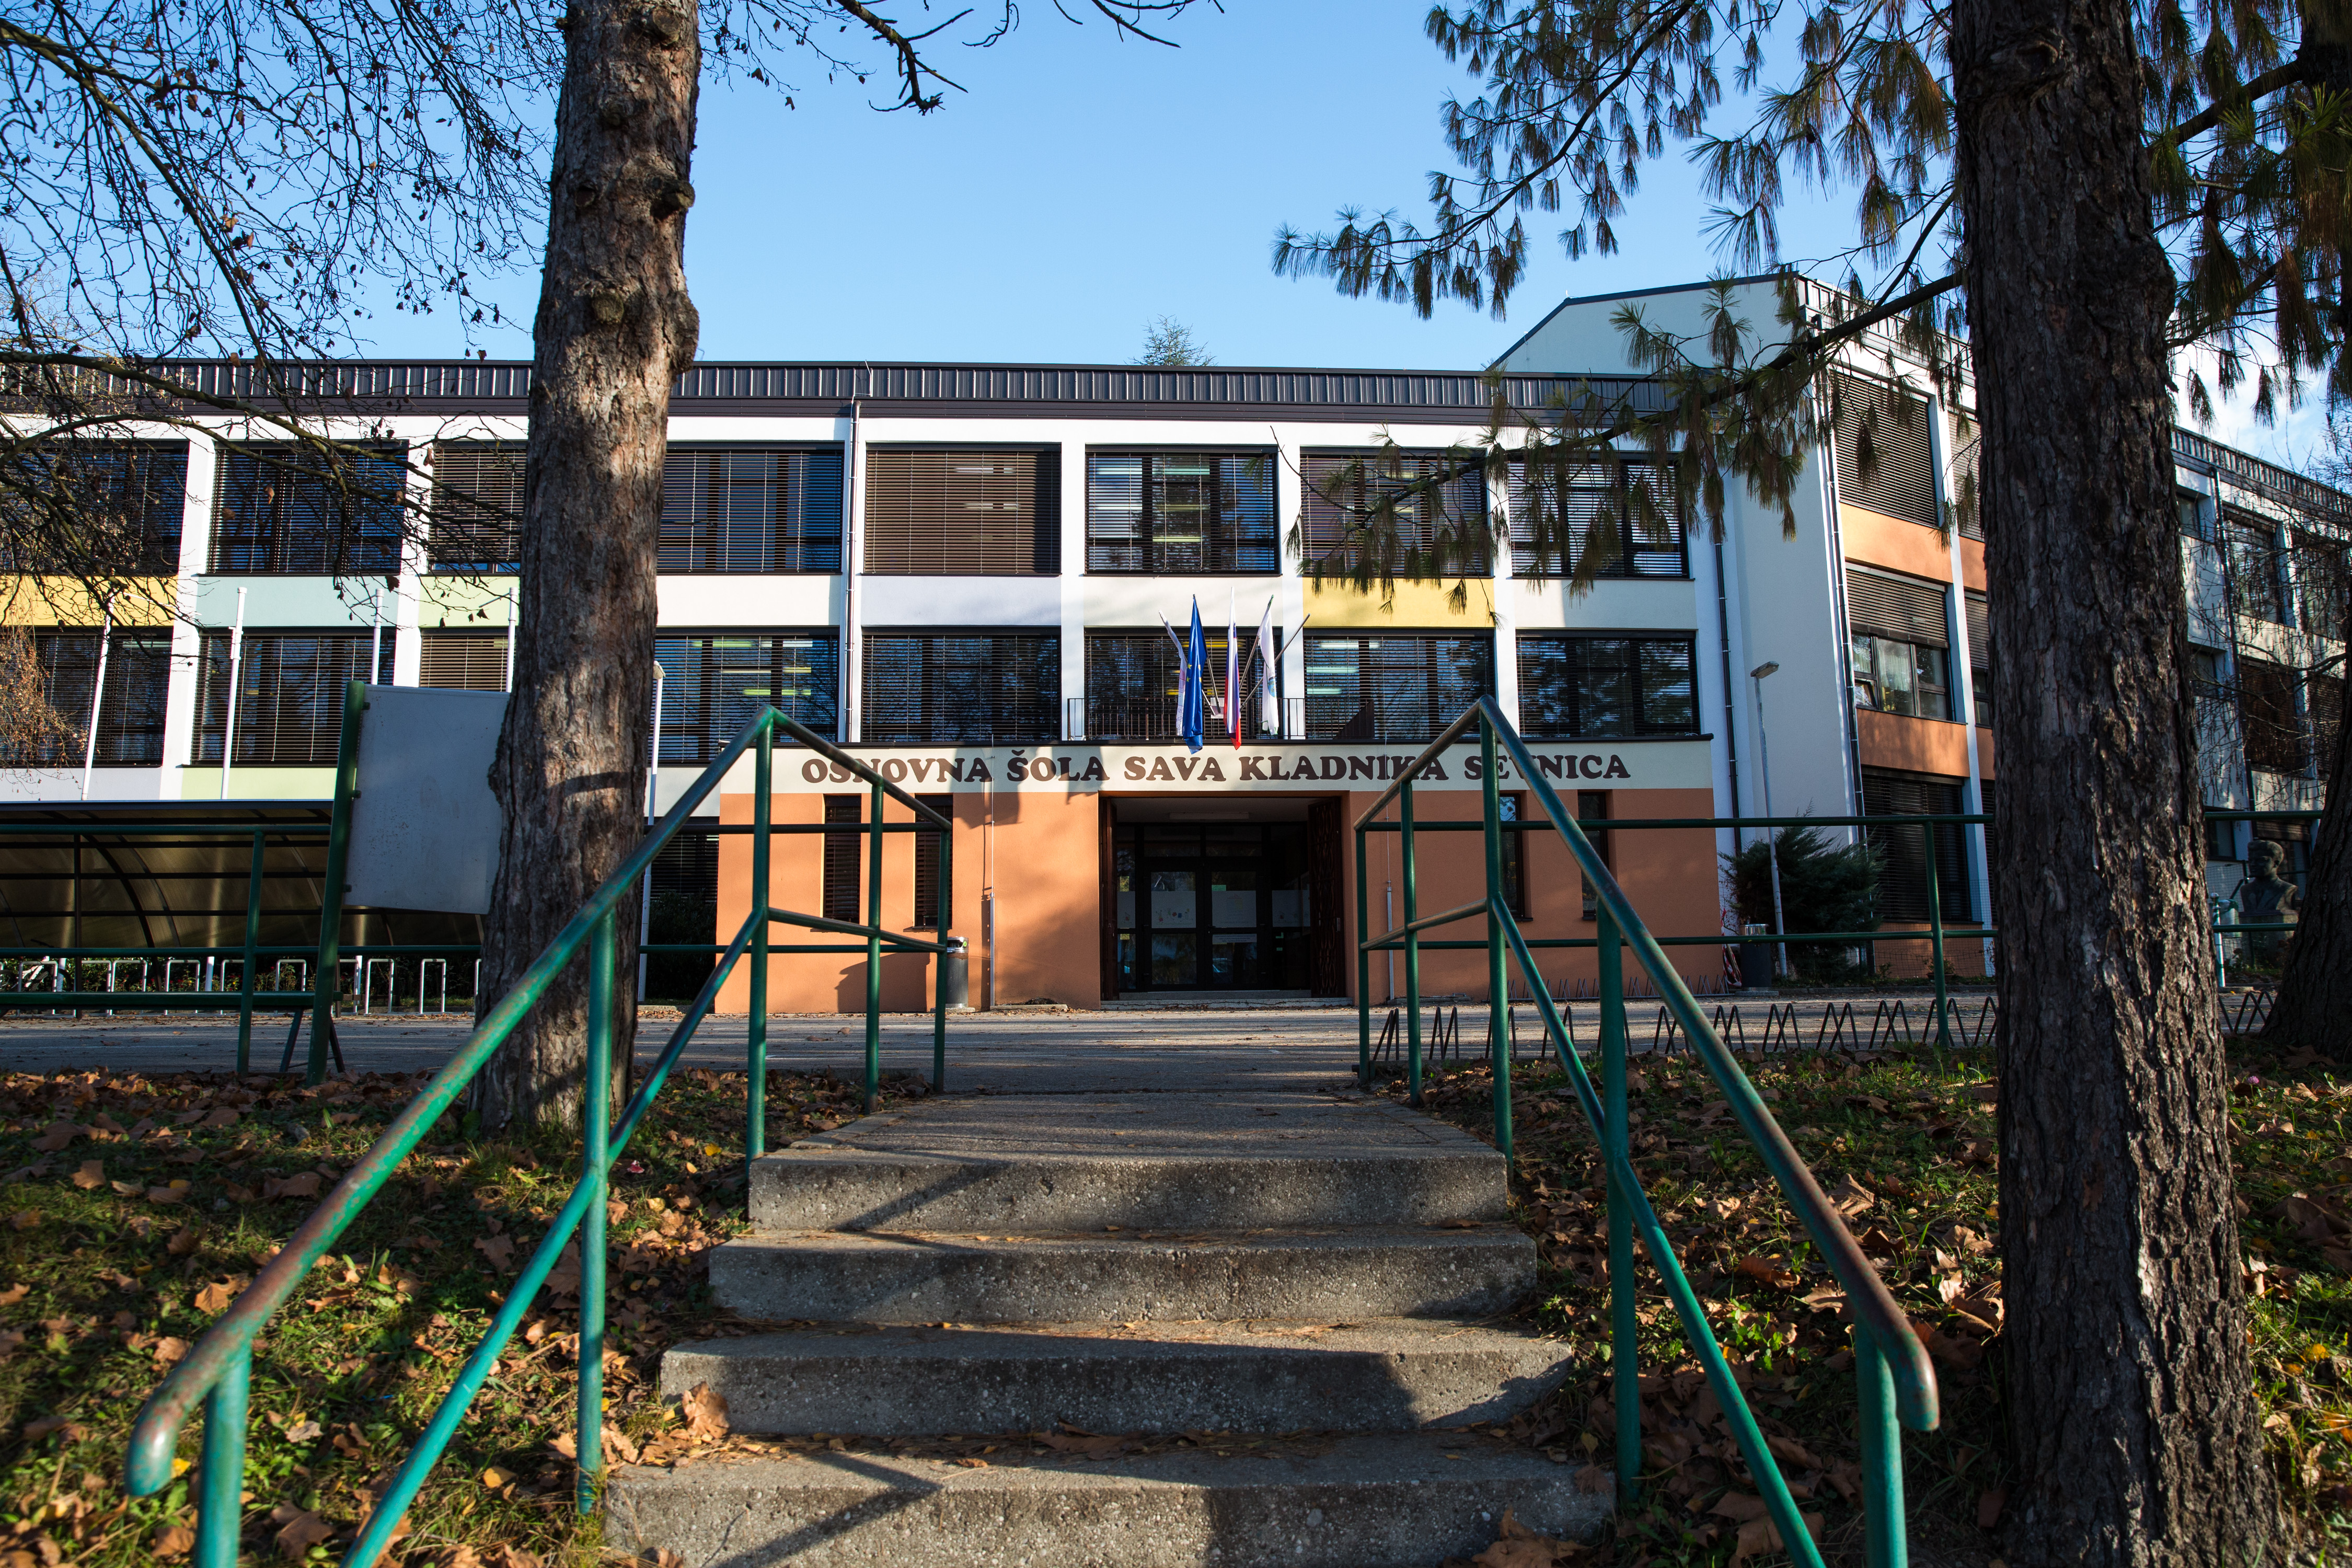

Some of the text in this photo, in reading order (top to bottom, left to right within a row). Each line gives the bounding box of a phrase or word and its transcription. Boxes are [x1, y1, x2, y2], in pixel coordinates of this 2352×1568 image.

[1007, 749, 1110, 782] ŠOLA
[1124, 756, 1227, 782] SAVA
[1238, 755, 1449, 781] KLADNIKA
[1464, 754, 1631, 779] SENICA
